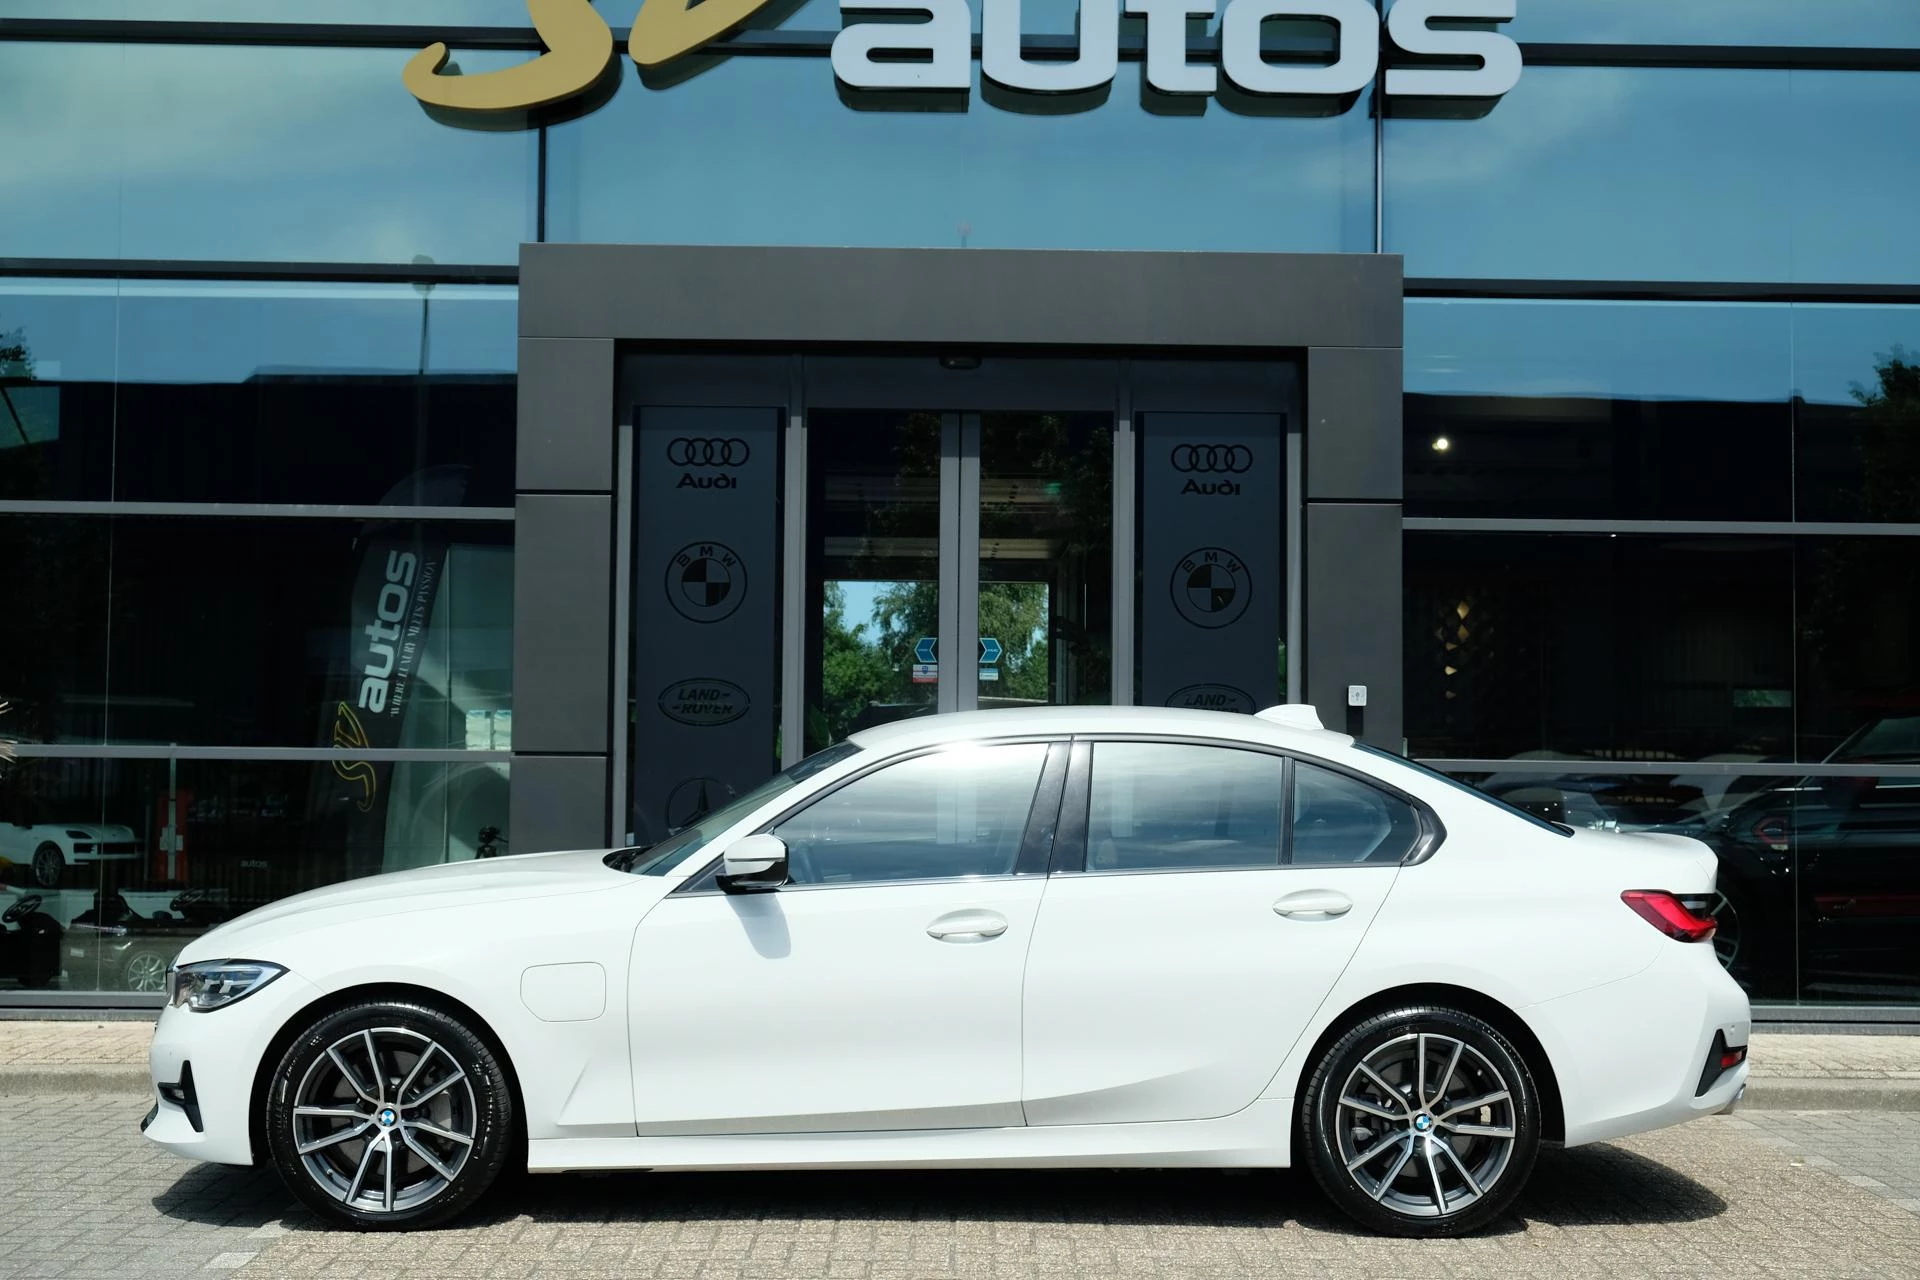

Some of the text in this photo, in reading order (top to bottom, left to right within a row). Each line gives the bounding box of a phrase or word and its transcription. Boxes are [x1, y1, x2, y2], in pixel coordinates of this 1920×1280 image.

[831, 0, 1523, 96] autos
[676, 473, 737, 489] Audi
[1181, 479, 1241, 495] Audi
[677, 546, 737, 568] BMW
[1182, 551, 1241, 574] BMW
[358, 550, 417, 713] autos
